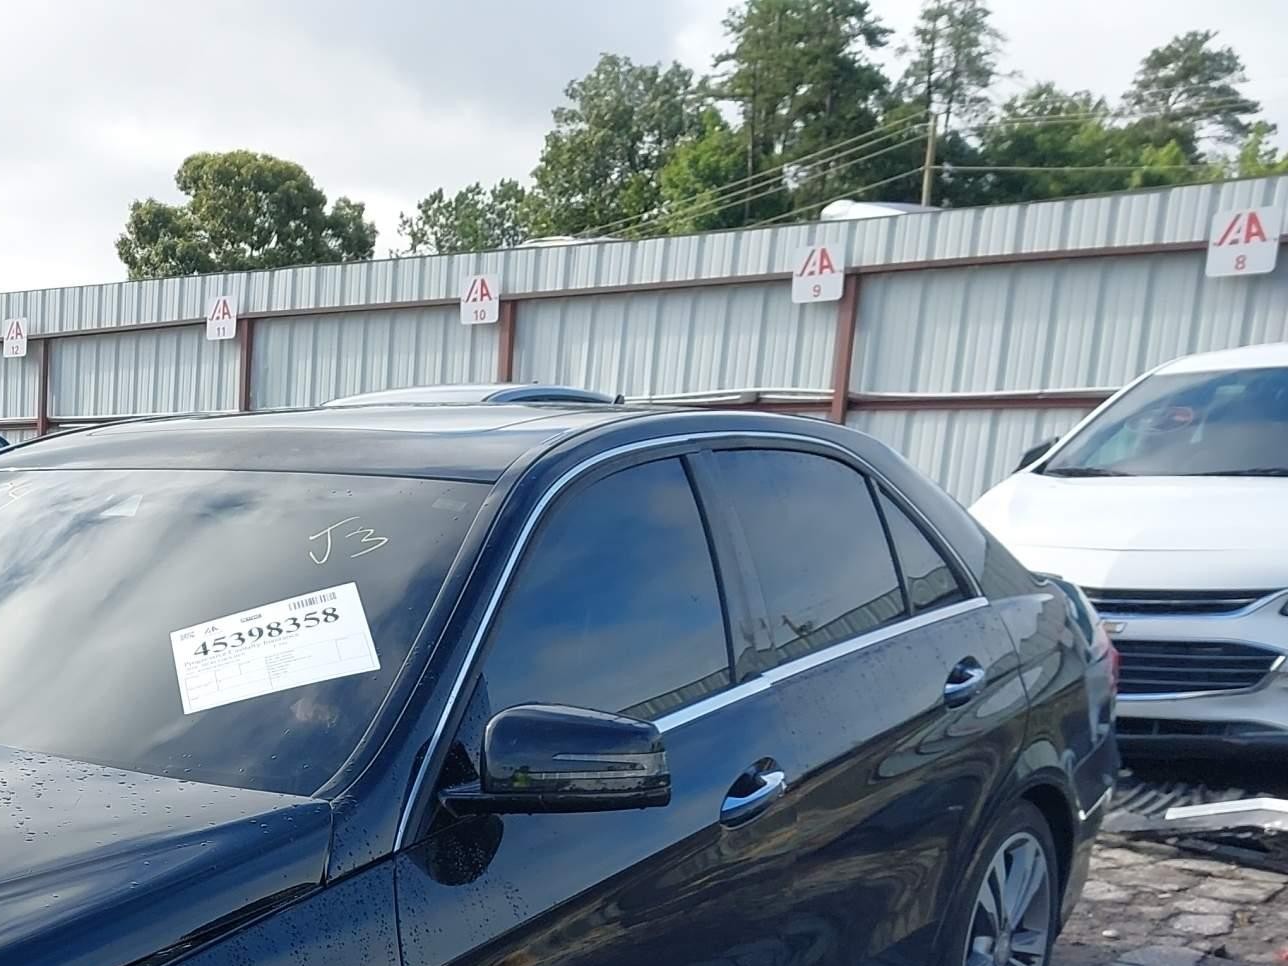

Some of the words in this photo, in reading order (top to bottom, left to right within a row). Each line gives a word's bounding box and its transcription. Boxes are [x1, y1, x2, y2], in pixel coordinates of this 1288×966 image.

[1234, 254, 1247, 271] 8
[812, 284, 822, 298] 9
[473, 309, 486, 321] 10
[216, 327, 227, 337] 11
[11, 345, 19, 355] 12
[194, 606, 340, 656] 45398358
